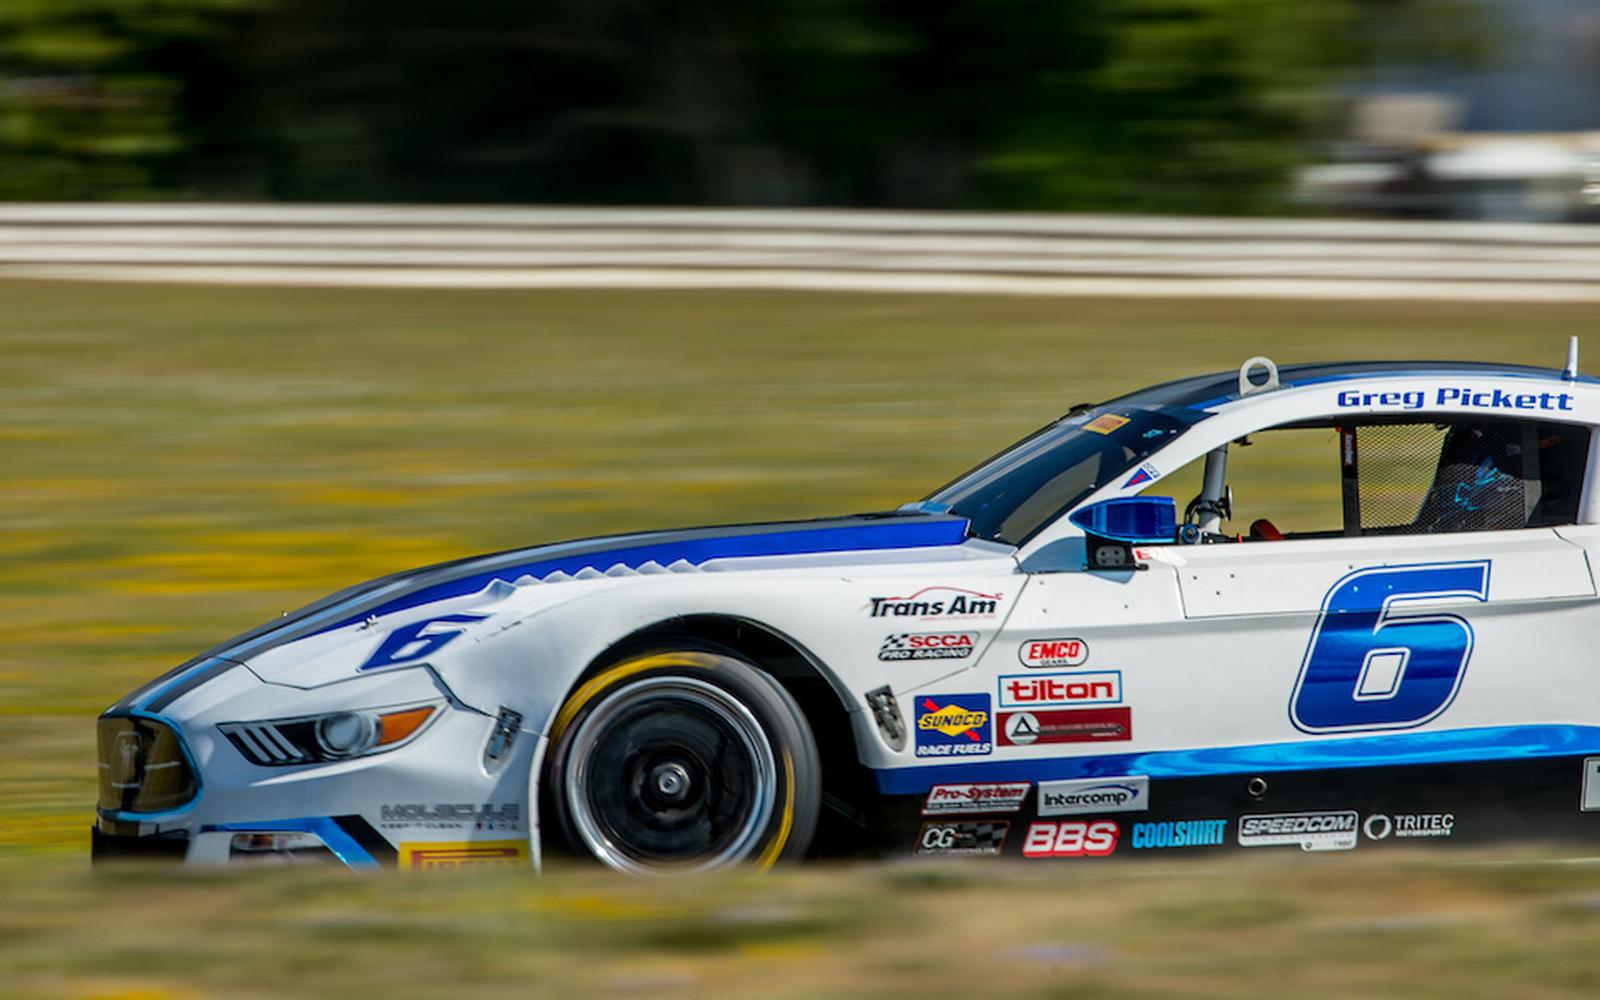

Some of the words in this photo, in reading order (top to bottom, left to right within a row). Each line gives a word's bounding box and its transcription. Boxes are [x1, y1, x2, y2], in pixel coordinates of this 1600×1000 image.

[1337, 389, 1425, 409] Greg
[1436, 387, 1574, 411] Pickett
[869, 597, 944, 618] Trans
[947, 595, 996, 615] Am
[358, 613, 491, 671] 6
[908, 634, 973, 648] SCCA
[1028, 641, 1080, 660] EMCO
[1288, 559, 1492, 735] 6
[881, 651, 911, 660] PRO
[912, 647, 970, 659] RACING
[1007, 679, 1113, 702] tilton
[922, 714, 983, 727] SUNOCO
[917, 745, 953, 755] RACE
[953, 742, 992, 754] FUELS
[1044, 792, 1128, 806] Intercomp
[1242, 815, 1355, 835] SPEEDCOM
[1394, 813, 1454, 829] TRITEC
[922, 828, 956, 849] CG
[1023, 820, 1119, 857] BBS
[1132, 820, 1227, 848] COOLSHIRT
